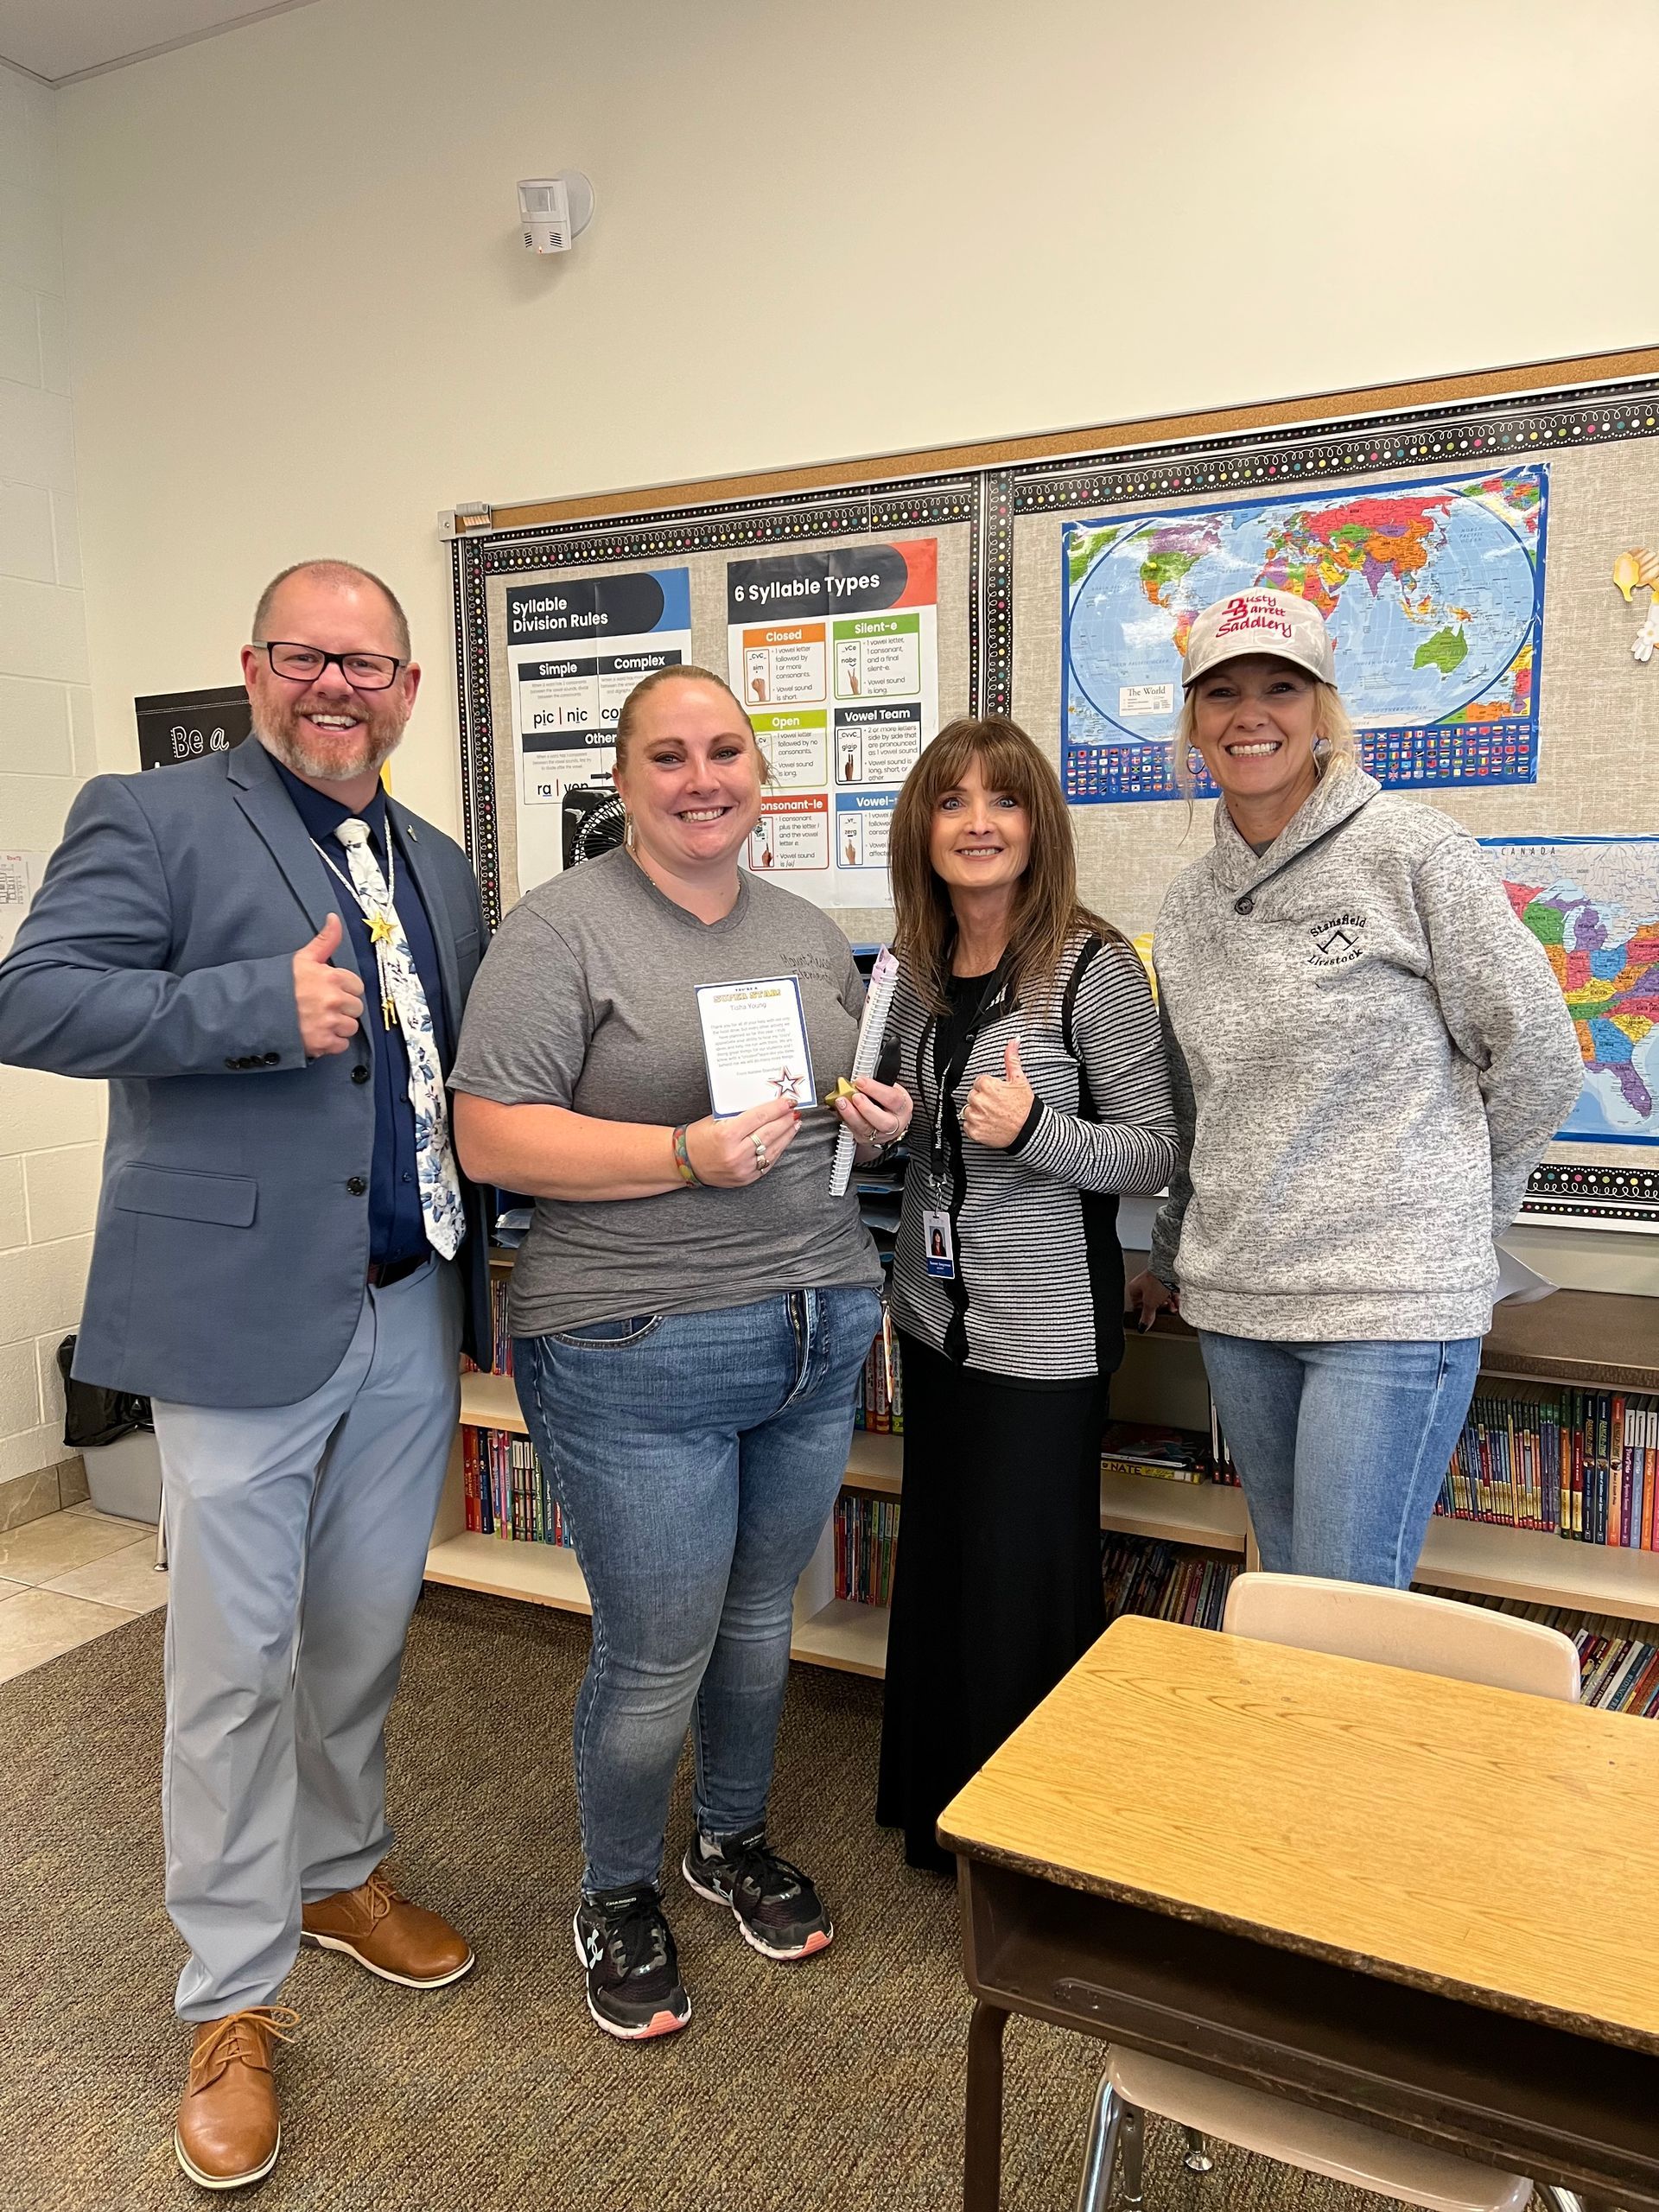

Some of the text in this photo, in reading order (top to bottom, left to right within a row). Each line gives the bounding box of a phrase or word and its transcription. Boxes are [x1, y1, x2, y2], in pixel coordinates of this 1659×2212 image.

[734, 574, 880, 604] 6 Syllable Types
[512, 596, 567, 618] Syllable
[1222, 602, 1287, 622] Barrett
[512, 612, 608, 633] Division Rules
[855, 622, 898, 634] Silent-e
[1216, 615, 1292, 639] Saddlery
[766, 629, 802, 642] Closed
[539, 656, 665, 677] Simple Complex
[1127, 685, 1166, 696] The World
[533, 709, 555, 728] pic
[567, 708, 588, 722] nic
[845, 709, 911, 722] Vowel Team
[772, 717, 800, 729] Open
[170, 726, 230, 759] Be a
[585, 734, 617, 745] Other
[880, 740, 917, 748] pronounced
[537, 784, 551, 795] ra
[760, 799, 823, 810] onsonant-le
[1501, 847, 1556, 855] CANADA
[1310, 913, 1367, 938] Stansfield
[1307, 948, 1363, 966] Livestock
[713, 988, 781, 1002] SUPER STAR!
[1111, 1463, 1141, 1475] NATE
